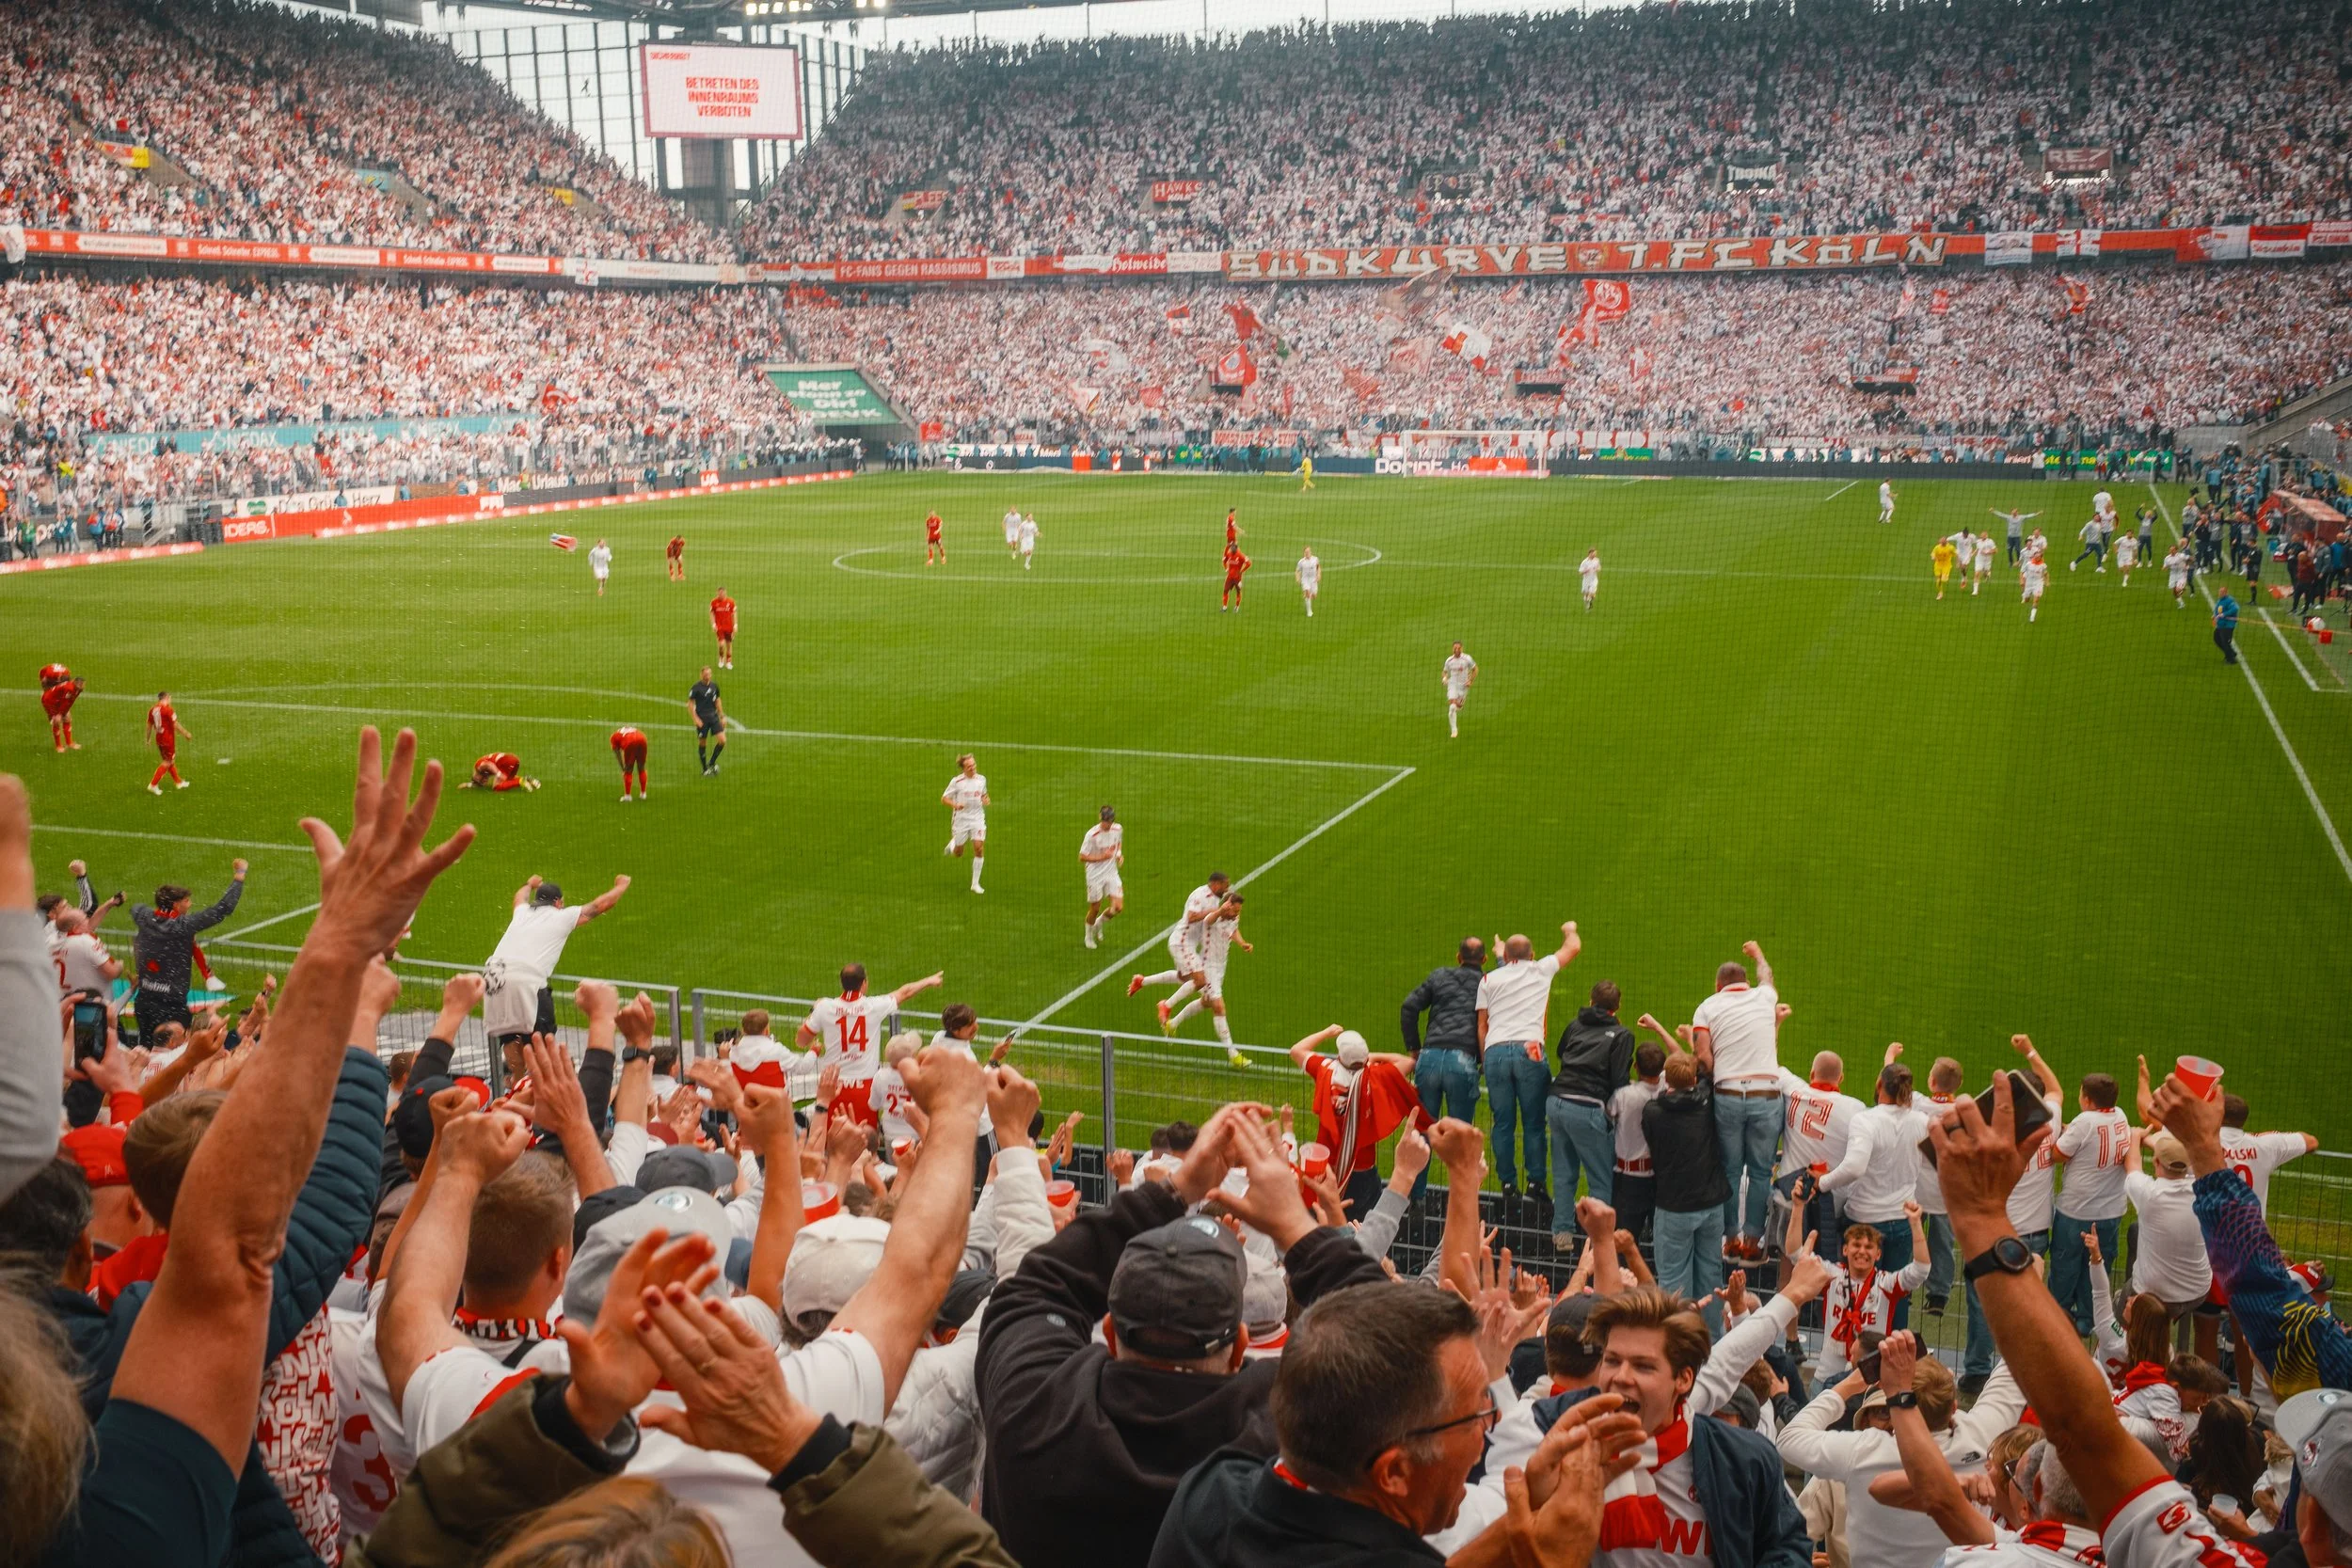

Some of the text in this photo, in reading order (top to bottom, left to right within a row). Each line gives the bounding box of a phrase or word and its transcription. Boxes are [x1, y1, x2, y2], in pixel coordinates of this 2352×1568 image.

[686, 76, 760, 89] BETRETEN DES
[688, 91, 759, 103] INNENRAUMS
[697, 105, 752, 118] VERBOTEN
[1112, 256, 1167, 273] Holweide
[1229, 244, 1568, 278] SÜDKURVE
[1770, 235, 1945, 268] KÖLN
[840, 263, 882, 278] FC-FANS
[884, 261, 918, 277] GEGEN
[920, 261, 981, 276] RASSISMUS
[498, 477, 522, 493] Mac
[532, 472, 568, 490] Urlaub
[352, 494, 381, 508] Herz
[834, 1015, 869, 1053] 14
[1788, 1091, 1834, 1141] 12
[2097, 1120, 2131, 1170] 12
[2221, 1147, 2257, 1161] DOLSKI
[1832, 1304, 1877, 1325] RE
